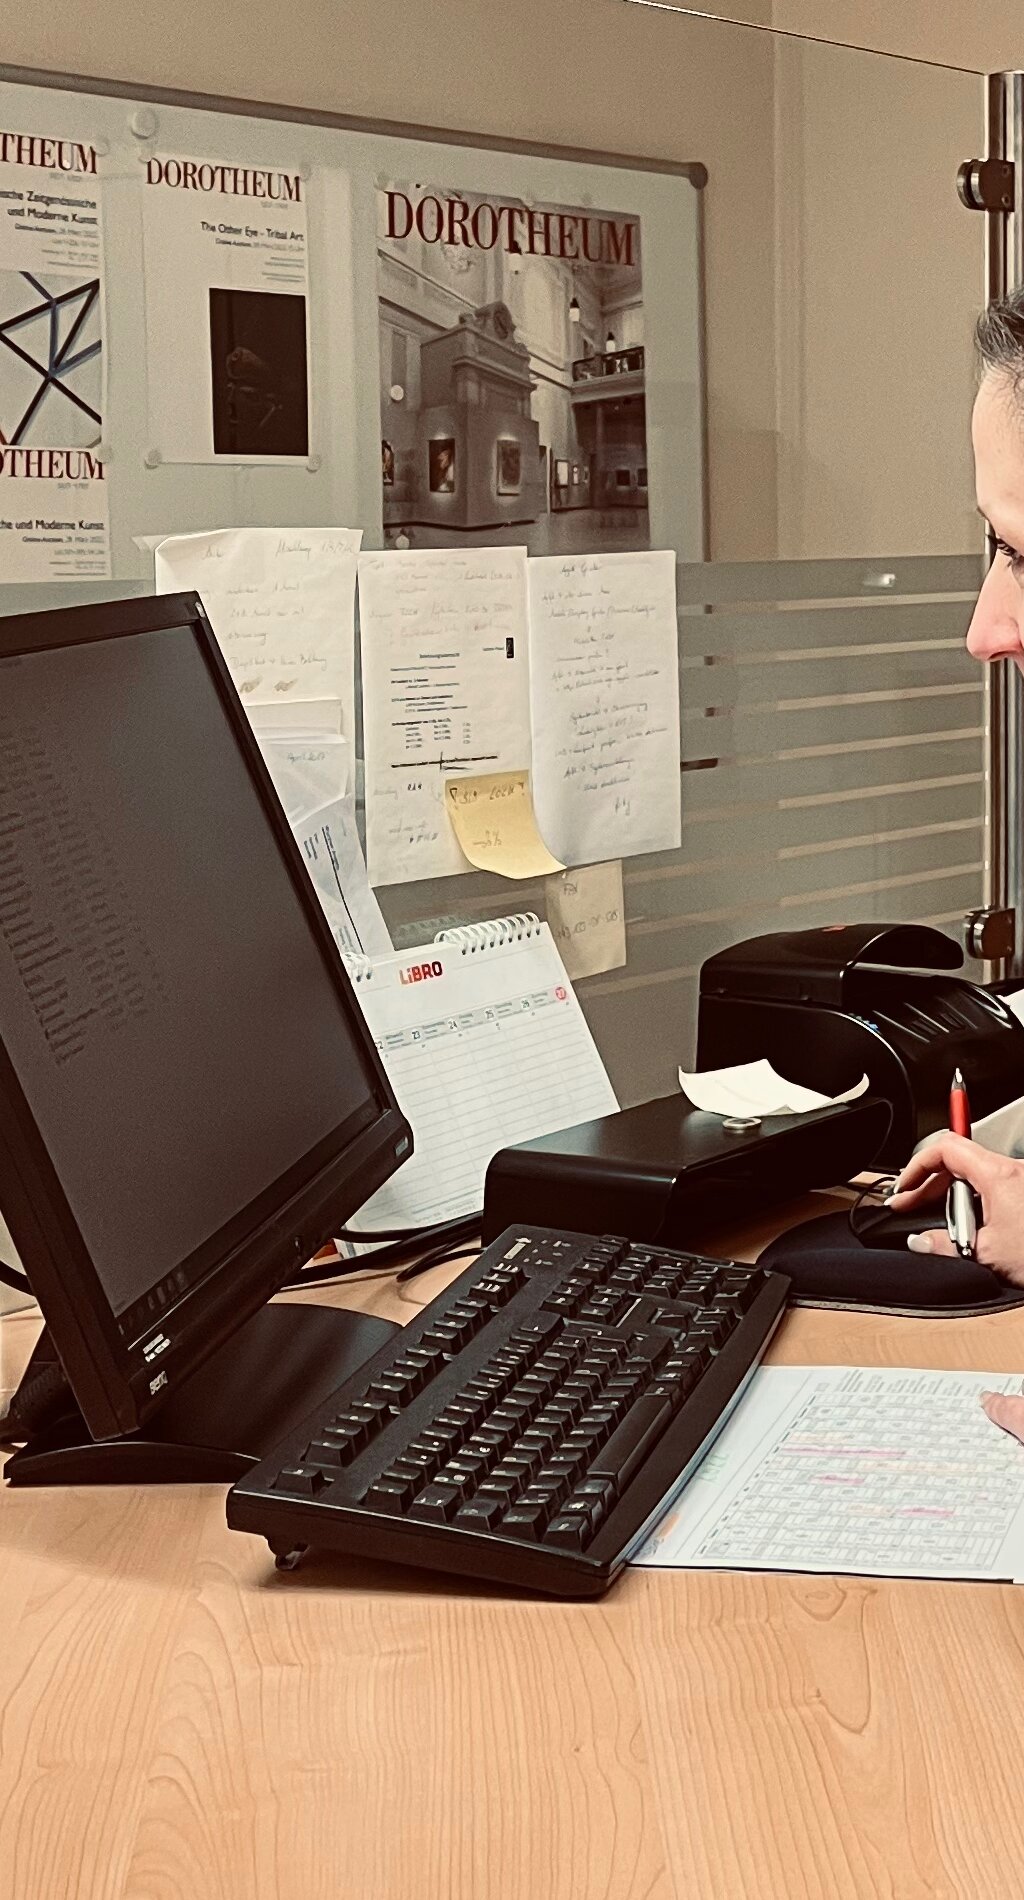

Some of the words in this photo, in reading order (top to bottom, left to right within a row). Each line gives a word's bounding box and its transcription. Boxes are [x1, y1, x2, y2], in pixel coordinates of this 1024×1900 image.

[0, 131, 97, 175] THEUM
[146, 157, 302, 202] DOROTHEUM
[200, 221, 216, 232] The
[218, 223, 242, 235] Other
[244, 226, 258, 238] Eye
[266, 228, 287, 240] Tribal
[289, 231, 304, 241] Art
[384, 191, 636, 267] DOROTHEUM
[0, 449, 105, 480] THEUM
[15, 519, 33, 530] und
[35, 519, 76, 531] Moderne
[78, 519, 105, 531] Kunst
[411, 1030, 421, 1040] 23
